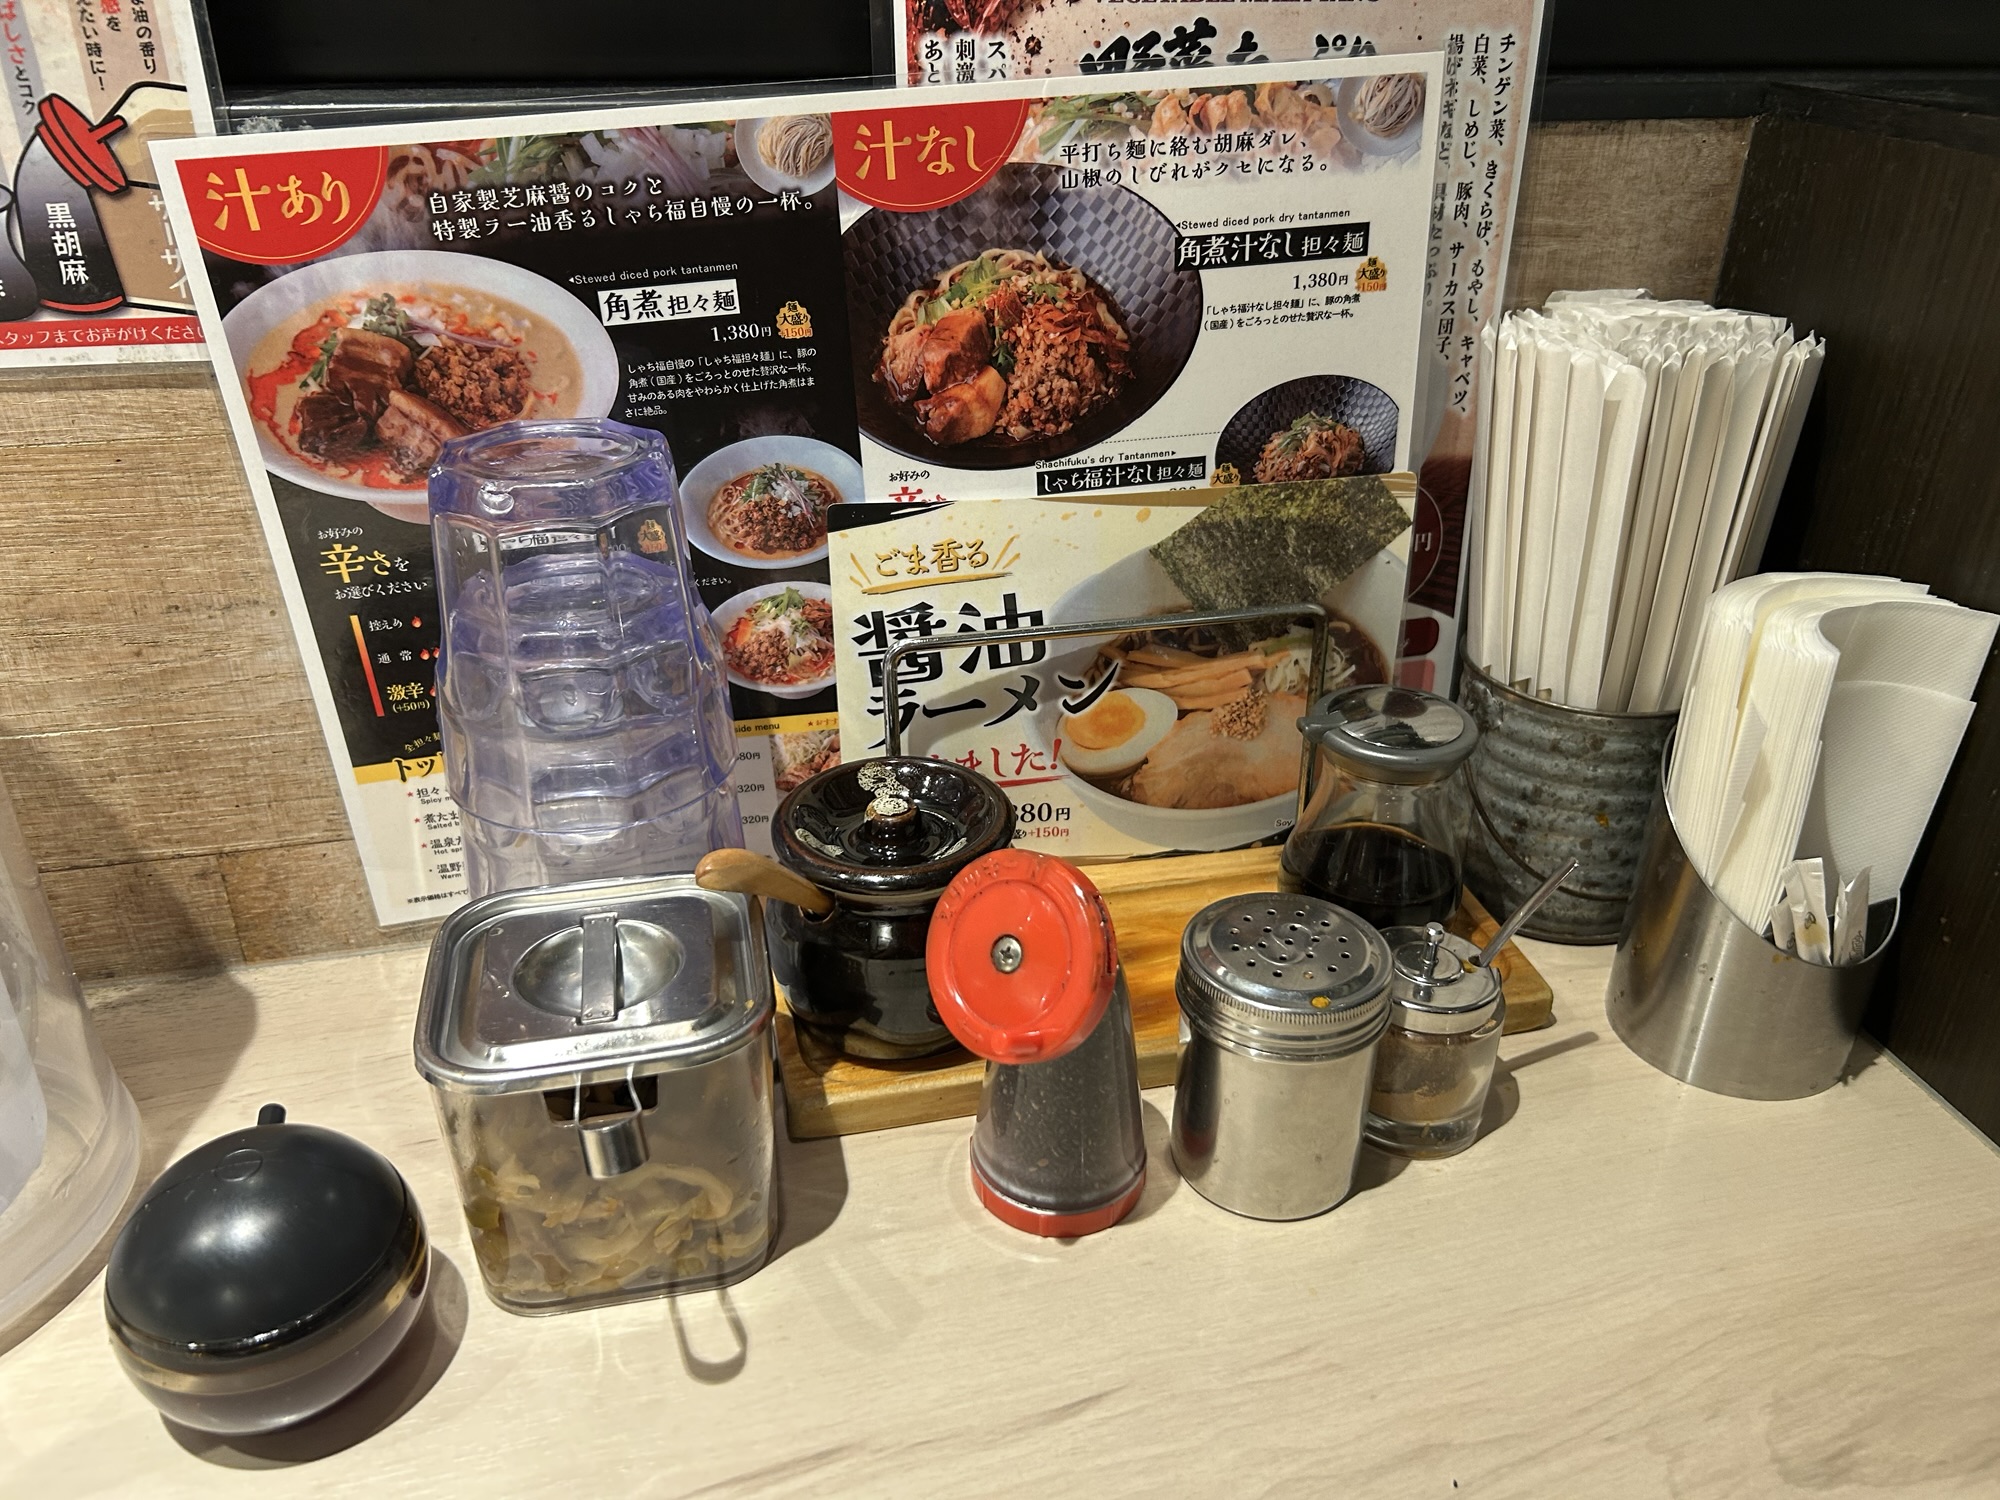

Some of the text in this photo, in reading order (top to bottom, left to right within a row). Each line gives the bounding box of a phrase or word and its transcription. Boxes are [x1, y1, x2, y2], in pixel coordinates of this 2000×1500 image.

[853, 119, 982, 182] 汁なし
[205, 167, 351, 232] 汁あり
[428, 175, 665, 216] 自家製芝麻醤のコクと
[1181, 209, 1351, 230] Stewed diced pork dry tantanmen
[45, 202, 90, 286] 黒胡麻
[1177, 231, 1365, 267] 角煮汁なし担々麺
[574, 262, 739, 285] Stewed diced pork tantanmen
[1292, 271, 1349, 291] 1,380円
[603, 288, 738, 323] 角煮担々麺
[0, 325, 206, 345] タッフまでお声がけくださ
[710, 322, 773, 343] 1,380円
[1034, 450, 1171, 470] Shachifuku's dry Tantanmen
[888, 469, 931, 482] お好みの
[1043, 461, 1204, 493] しゃち福汁なし担々麺
[317, 525, 364, 540] お好みの
[320, 543, 410, 584] 辛さを
[873, 537, 990, 576] ごま香る
[334, 581, 428, 601] お選びください
[851, 592, 1047, 688] 醤油
[386, 682, 425, 702] 激辛
[866, 662, 1120, 750] ラーメン
[754, 722, 780, 732] menu
[736, 751, 761, 761] 80円
[930, 738, 1063, 778] ました!
[394, 752, 443, 782] トッ
[420, 797, 442, 805] Spicy
[427, 821, 453, 831] Salted
[1275, 819, 1293, 827] Soy
[433, 847, 449, 856] Hot
[440, 872, 462, 880] Warm
